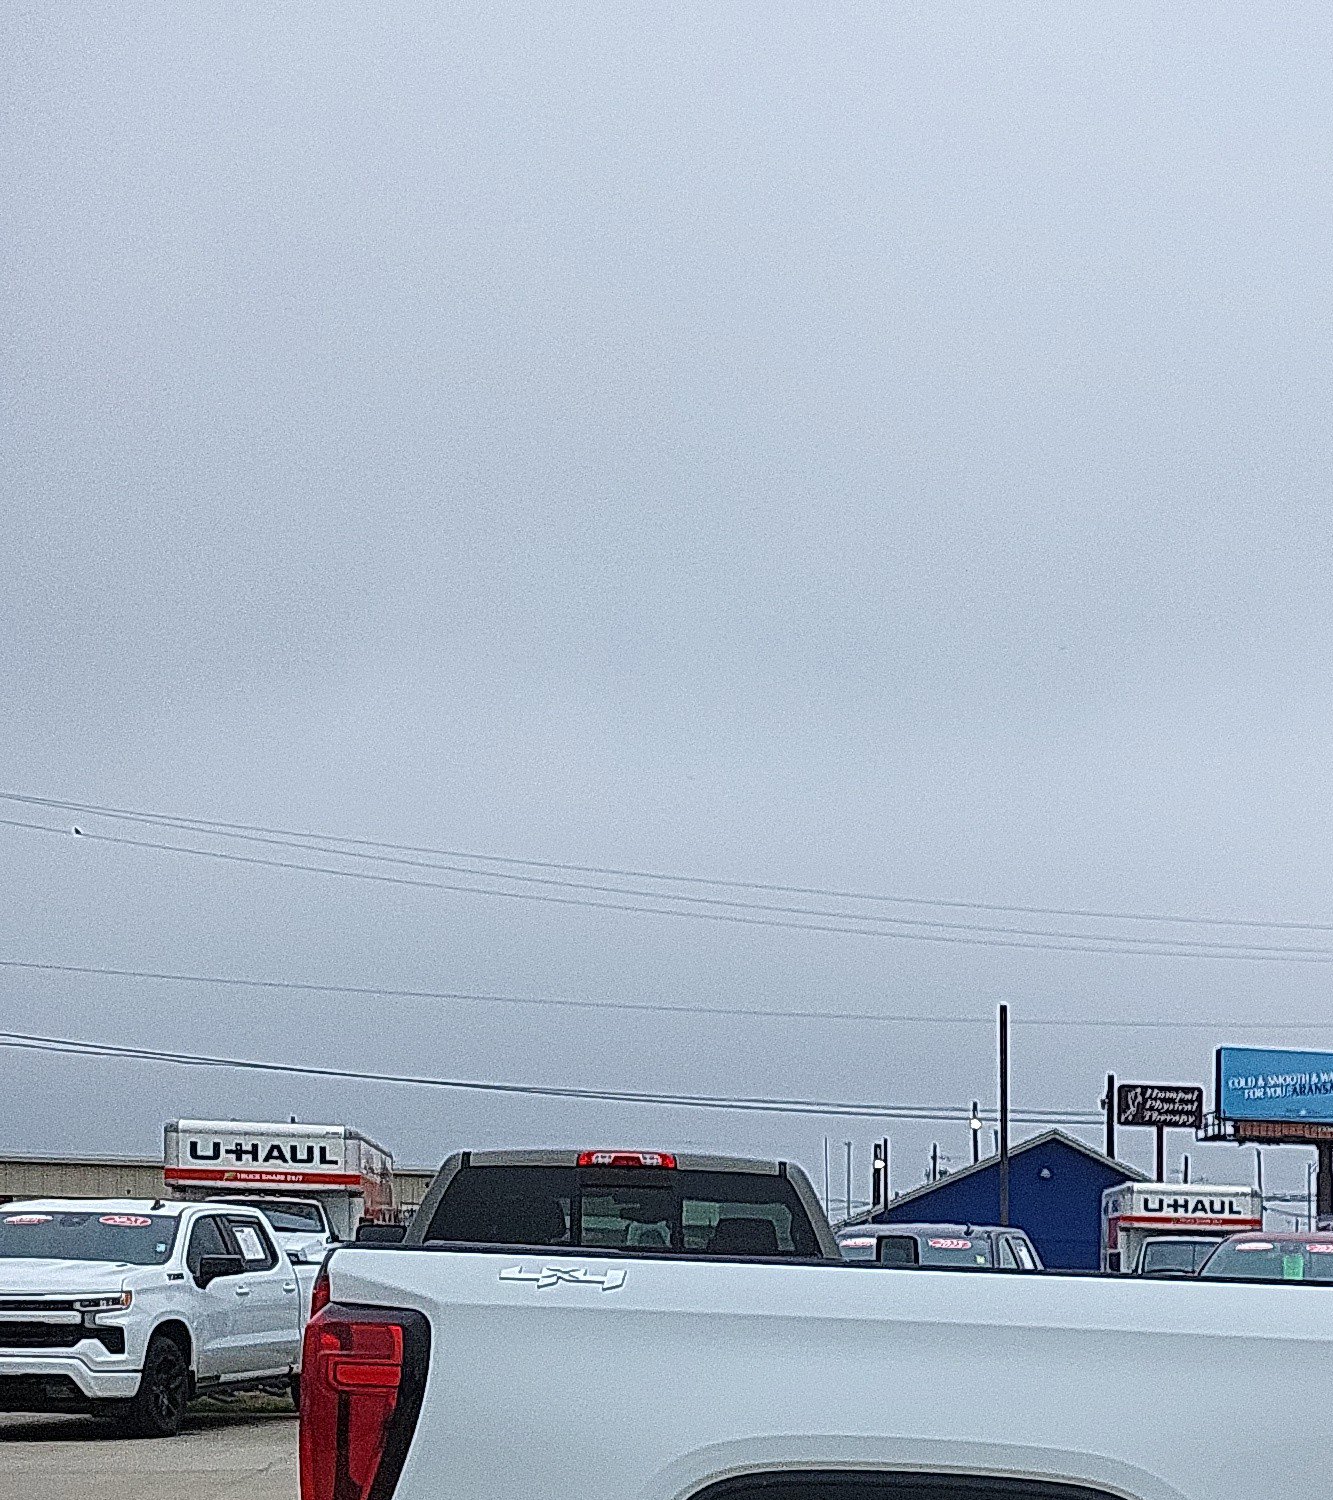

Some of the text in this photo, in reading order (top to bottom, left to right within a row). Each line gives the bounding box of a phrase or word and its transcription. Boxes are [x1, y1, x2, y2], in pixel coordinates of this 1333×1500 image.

[1267, 1073, 1309, 1087] SMOOTH
[1145, 1098, 1199, 1113] Physical
[1143, 1109, 1196, 1126] Therapy
[189, 1140, 339, 1166] U-HAUL
[1143, 1197, 1242, 1215] U-HAUL
